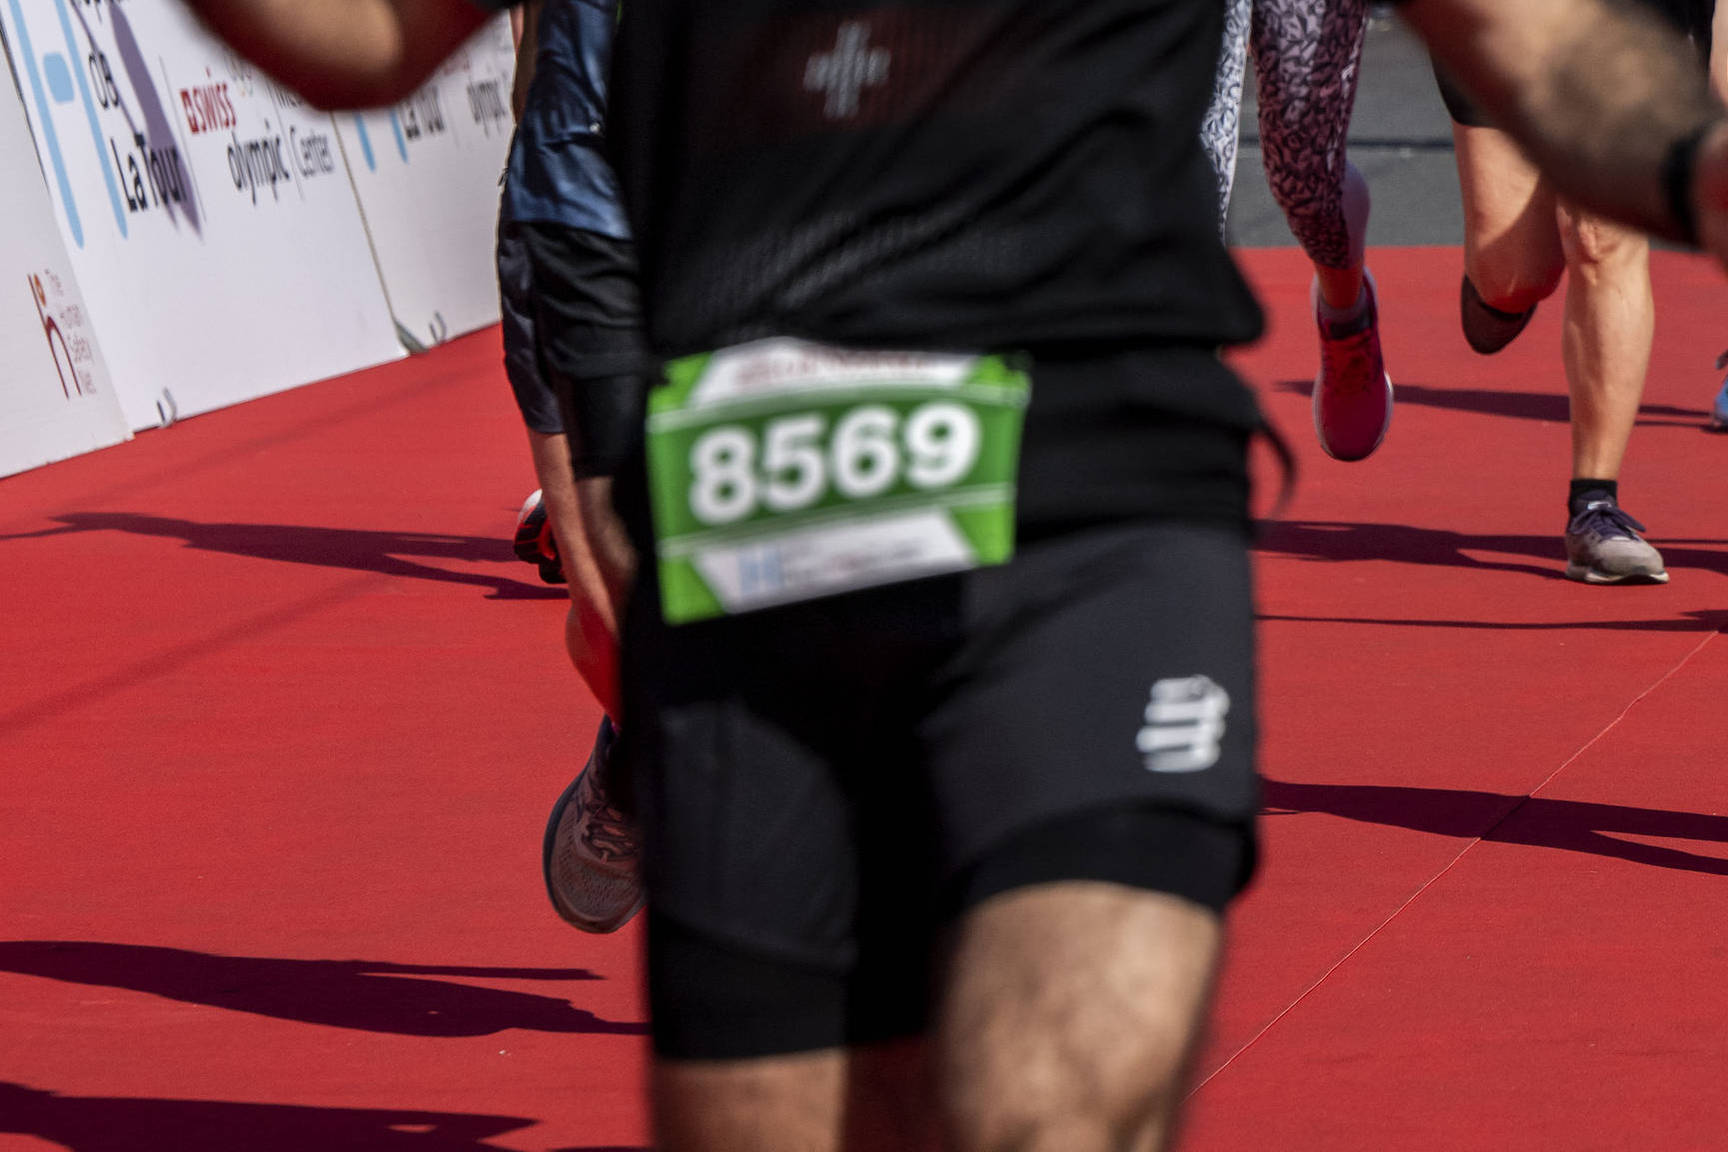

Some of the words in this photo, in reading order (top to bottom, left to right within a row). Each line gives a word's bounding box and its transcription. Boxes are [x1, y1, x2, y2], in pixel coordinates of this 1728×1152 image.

[87, 43, 120, 111] de
[108, 136, 149, 213] La
[226, 128, 291, 207] olympic
[687, 400, 983, 528] 8569
